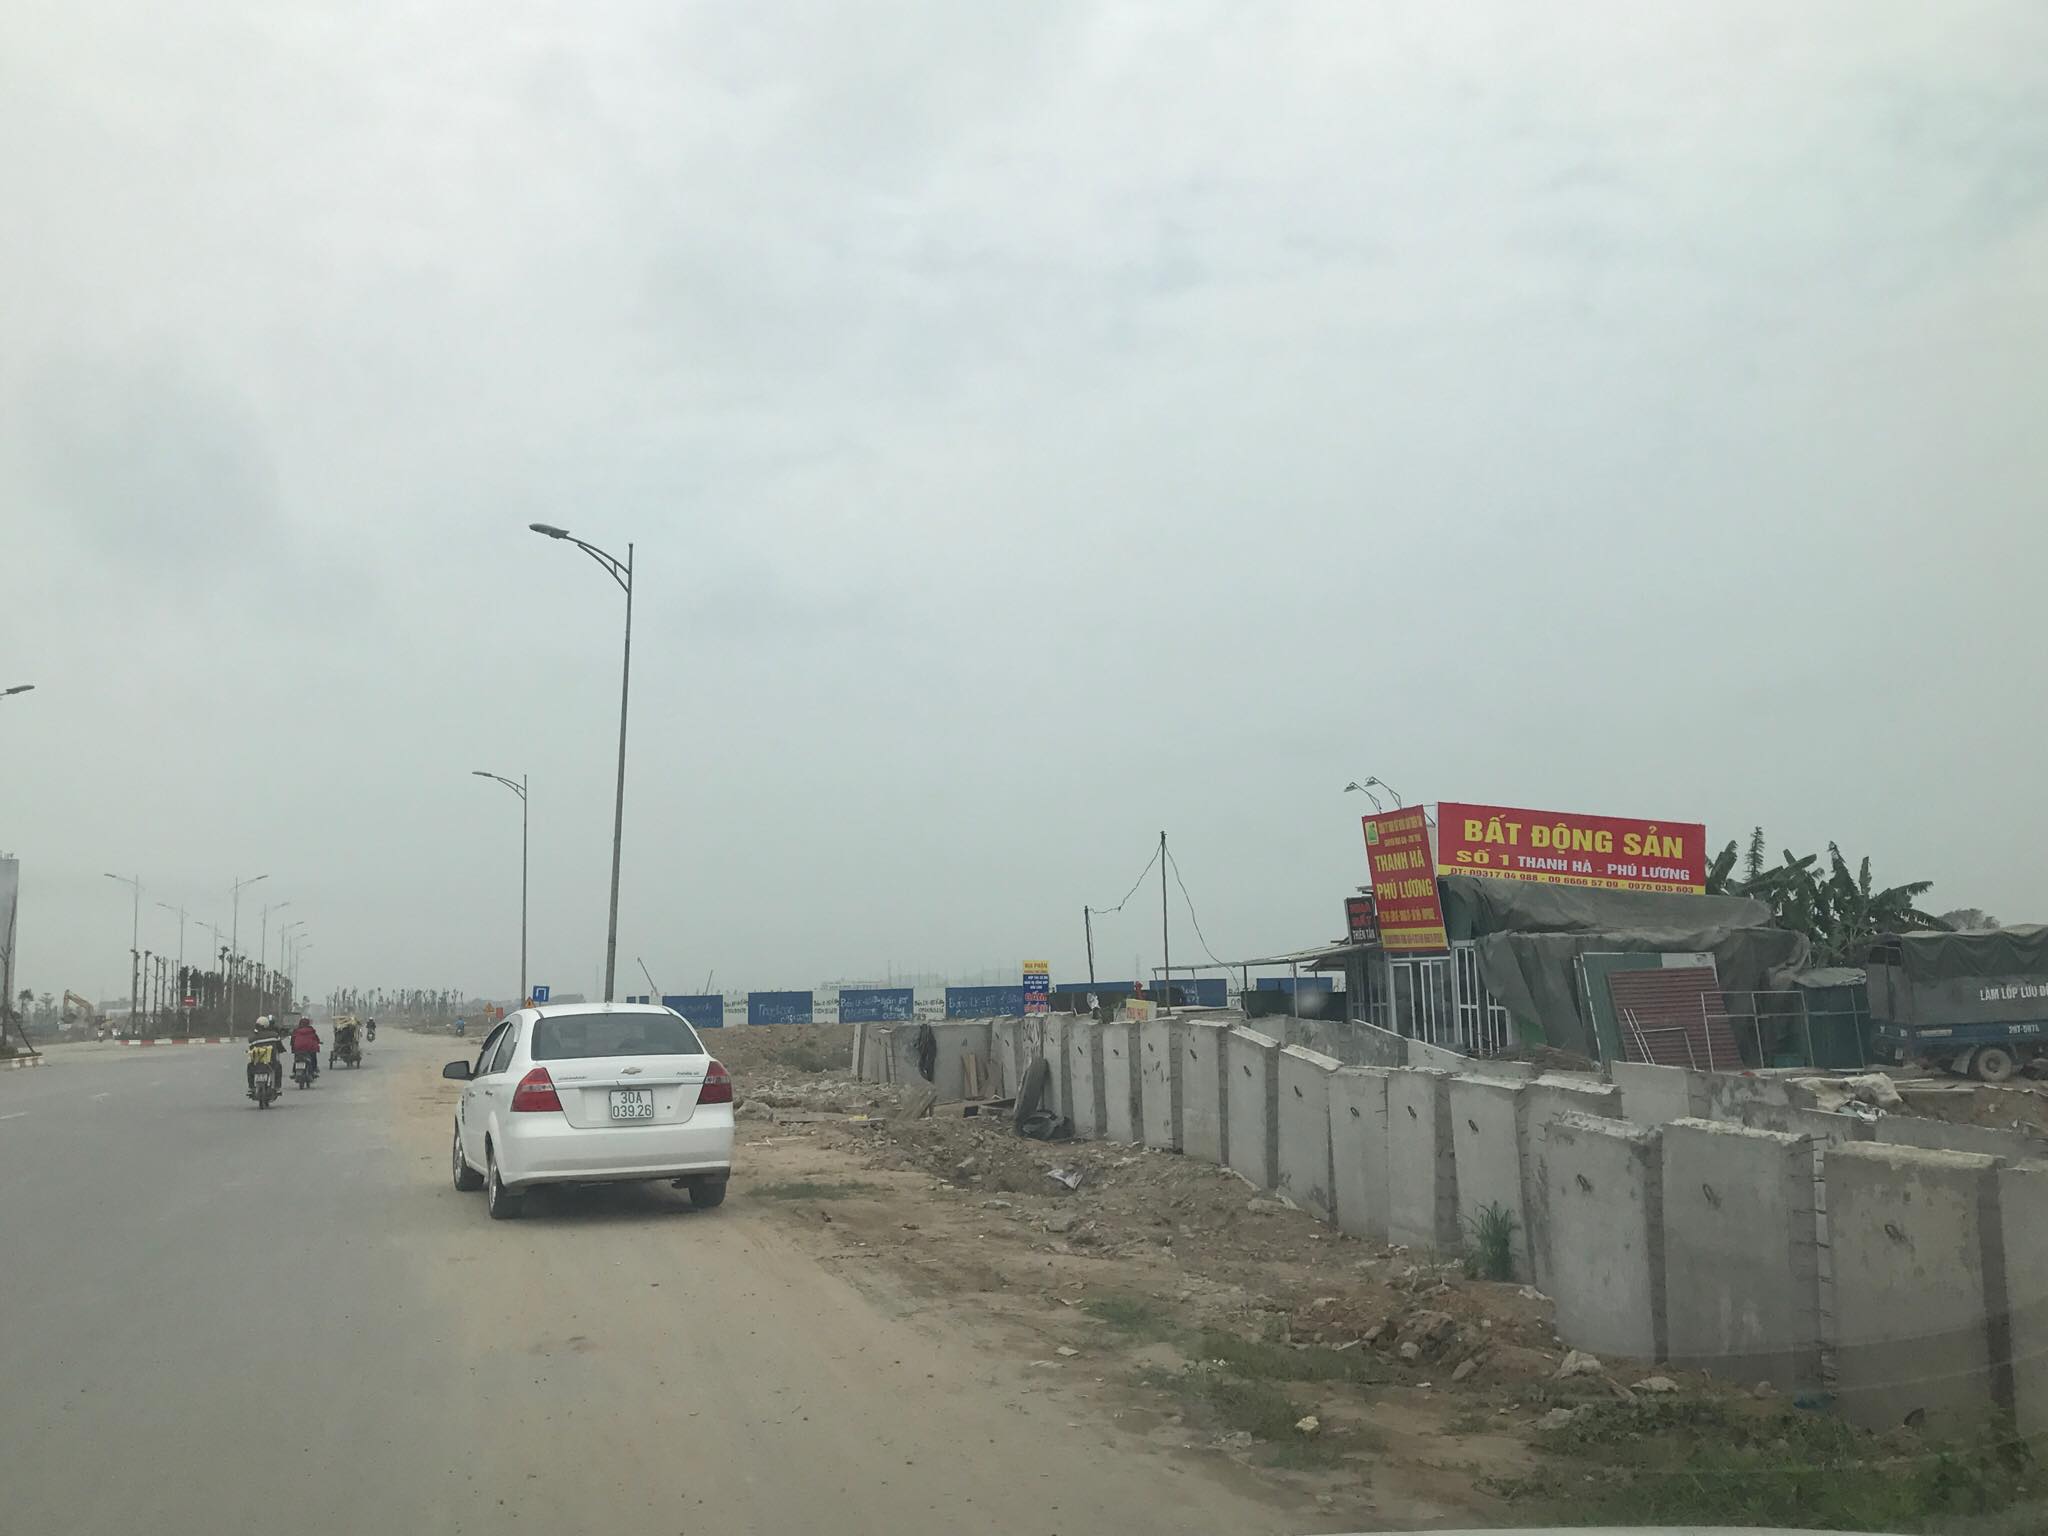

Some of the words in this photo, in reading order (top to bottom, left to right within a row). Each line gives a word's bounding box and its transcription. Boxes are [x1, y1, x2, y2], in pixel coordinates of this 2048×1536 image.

[1464, 814, 1522, 846] BẤT
[1531, 823, 1613, 855] ĐỘNG
[1623, 825, 1683, 859] SẢN
[1374, 850, 1409, 872] THANH
[1410, 846, 1426, 868] HÀ
[1456, 848, 1491, 864] SỐ
[1499, 854, 1510, 866] 1
[1518, 855, 1568, 871] THANH
[1572, 859, 1593, 873] HÀ
[1607, 863, 1637, 877] PHÚ
[1641, 865, 1690, 881] LƯƠNG
[1376, 879, 1398, 900] PHÚ
[1399, 878, 1434, 898] LƯƠNG
[620, 1091, 643, 1104] 30A
[612, 1105, 652, 1118] 039.26
